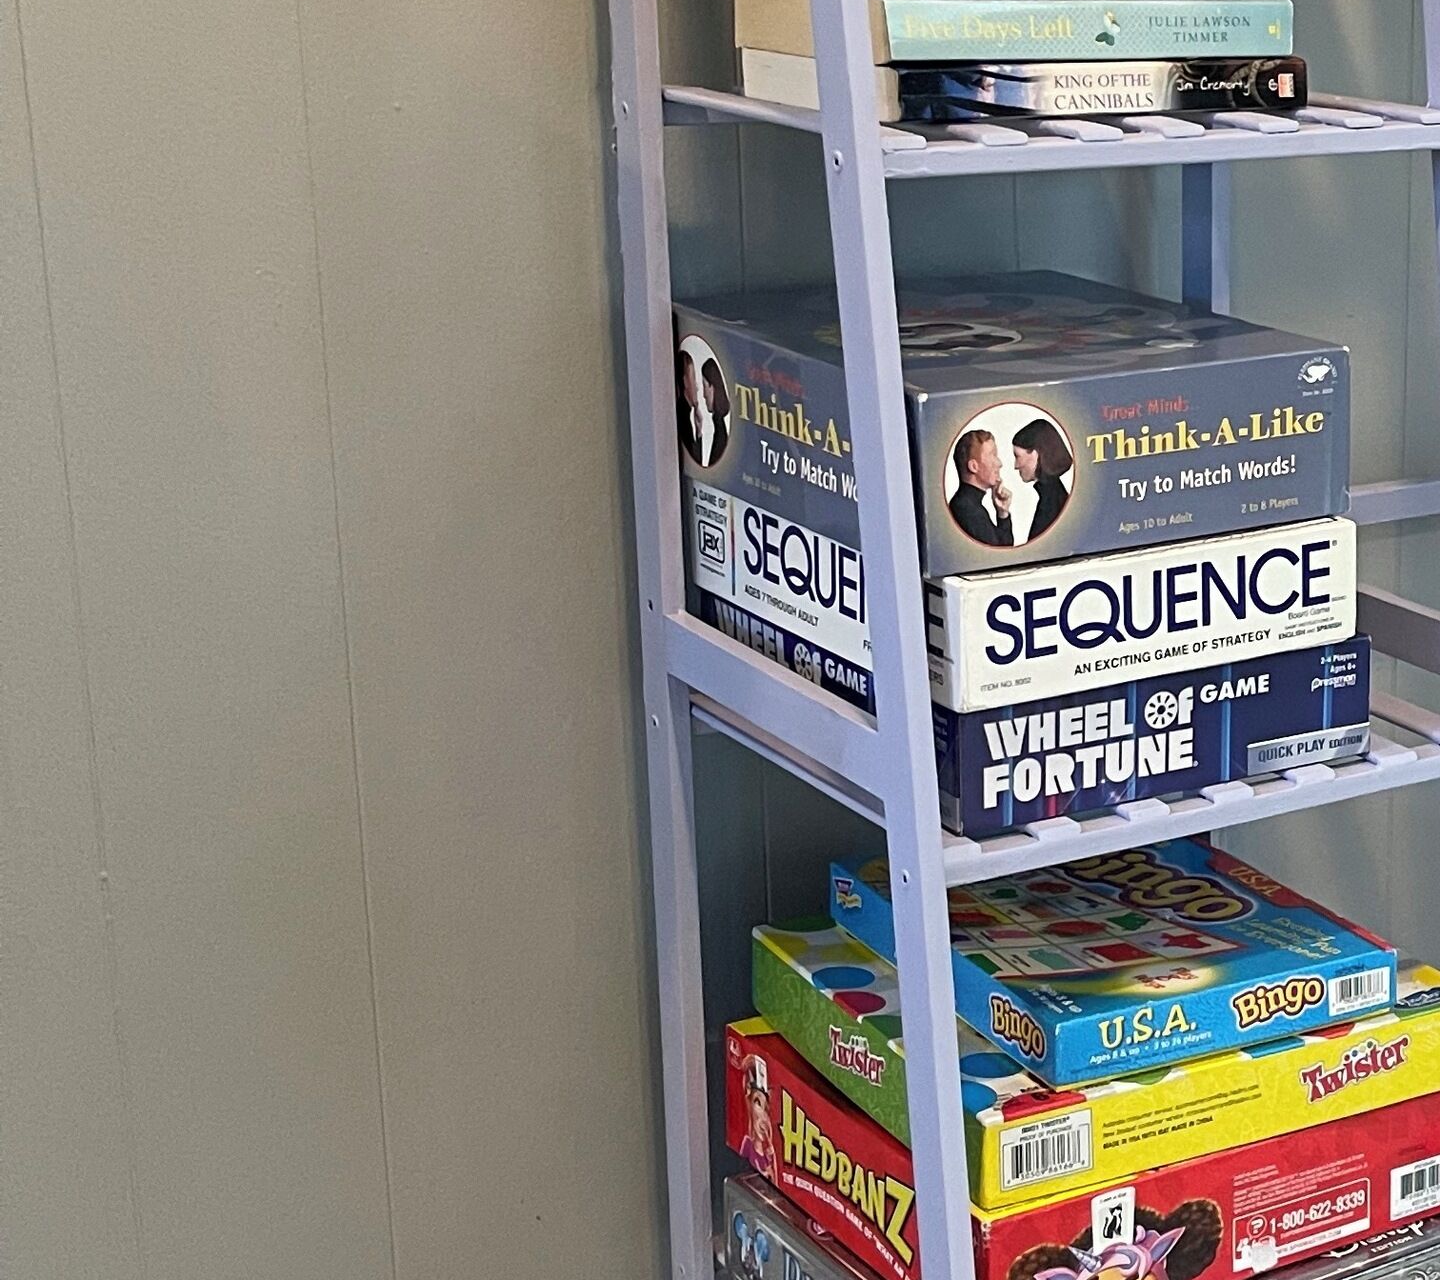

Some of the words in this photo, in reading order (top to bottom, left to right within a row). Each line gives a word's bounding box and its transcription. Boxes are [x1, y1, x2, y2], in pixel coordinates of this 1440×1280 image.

[903, 14, 953, 39] Five
[960, 14, 1023, 44] Days
[1028, 14, 1074, 39] Left
[1147, 15, 1186, 29] JULIE
[1191, 14, 1252, 29] LAWSON
[1173, 31, 1229, 45] TIMMER
[1053, 73, 1094, 89] KING
[1097, 73, 1119, 89] OF
[1119, 72, 1152, 88] THE
[1053, 91, 1155, 110] CANNIBALS
[1101, 400, 1144, 421] Great
[1146, 397, 1188, 417] Minds
[1085, 406, 1325, 465] Think-A-Like
[759, 440, 780, 475] Try
[783, 452, 798, 476] to
[800, 456, 838, 494] Match
[1117, 477, 1149, 502] Try
[1153, 475, 1174, 495] to
[1178, 465, 1233, 492] Match
[1237, 455, 1296, 483] Words!
[1117, 518, 1142, 536] Ages
[1155, 515, 1167, 528] to
[1167, 511, 1193, 527] Adult
[1269, 495, 1299, 512] Players
[744, 584, 761, 601] AGES
[766, 592, 797, 618] THROUGH
[798, 605, 820, 628] ADULT
[983, 540, 1333, 667] SEQUENCE
[714, 597, 790, 669] WHEEL
[824, 656, 868, 698] GAME
[1073, 661, 1091, 676] AN
[1094, 652, 1150, 673] EXCITING
[1151, 644, 1190, 665] GAME
[1191, 641, 1210, 657] OF
[1211, 628, 1272, 654] STRATEGY
[983, 698, 1133, 761] WHEEL
[1200, 673, 1271, 704] GAME
[983, 729, 1196, 809] FORTUNE
[1257, 746, 1294, 766] QUICK
[1296, 740, 1326, 758] PLAY
[1328, 732, 1364, 751] EDITION
[1232, 977, 1325, 1029] Bingo
[990, 995, 1046, 1060] Bingo
[1099, 1004, 1198, 1051] U.S.A.
[828, 1023, 886, 1087] Twister
[1300, 1036, 1410, 1103] Twister
[779, 1090, 916, 1263] HEDBANZ
[1269, 1188, 1366, 1233] 1-800-622-8339
[1370, 1234, 1413, 1253] EDITION
